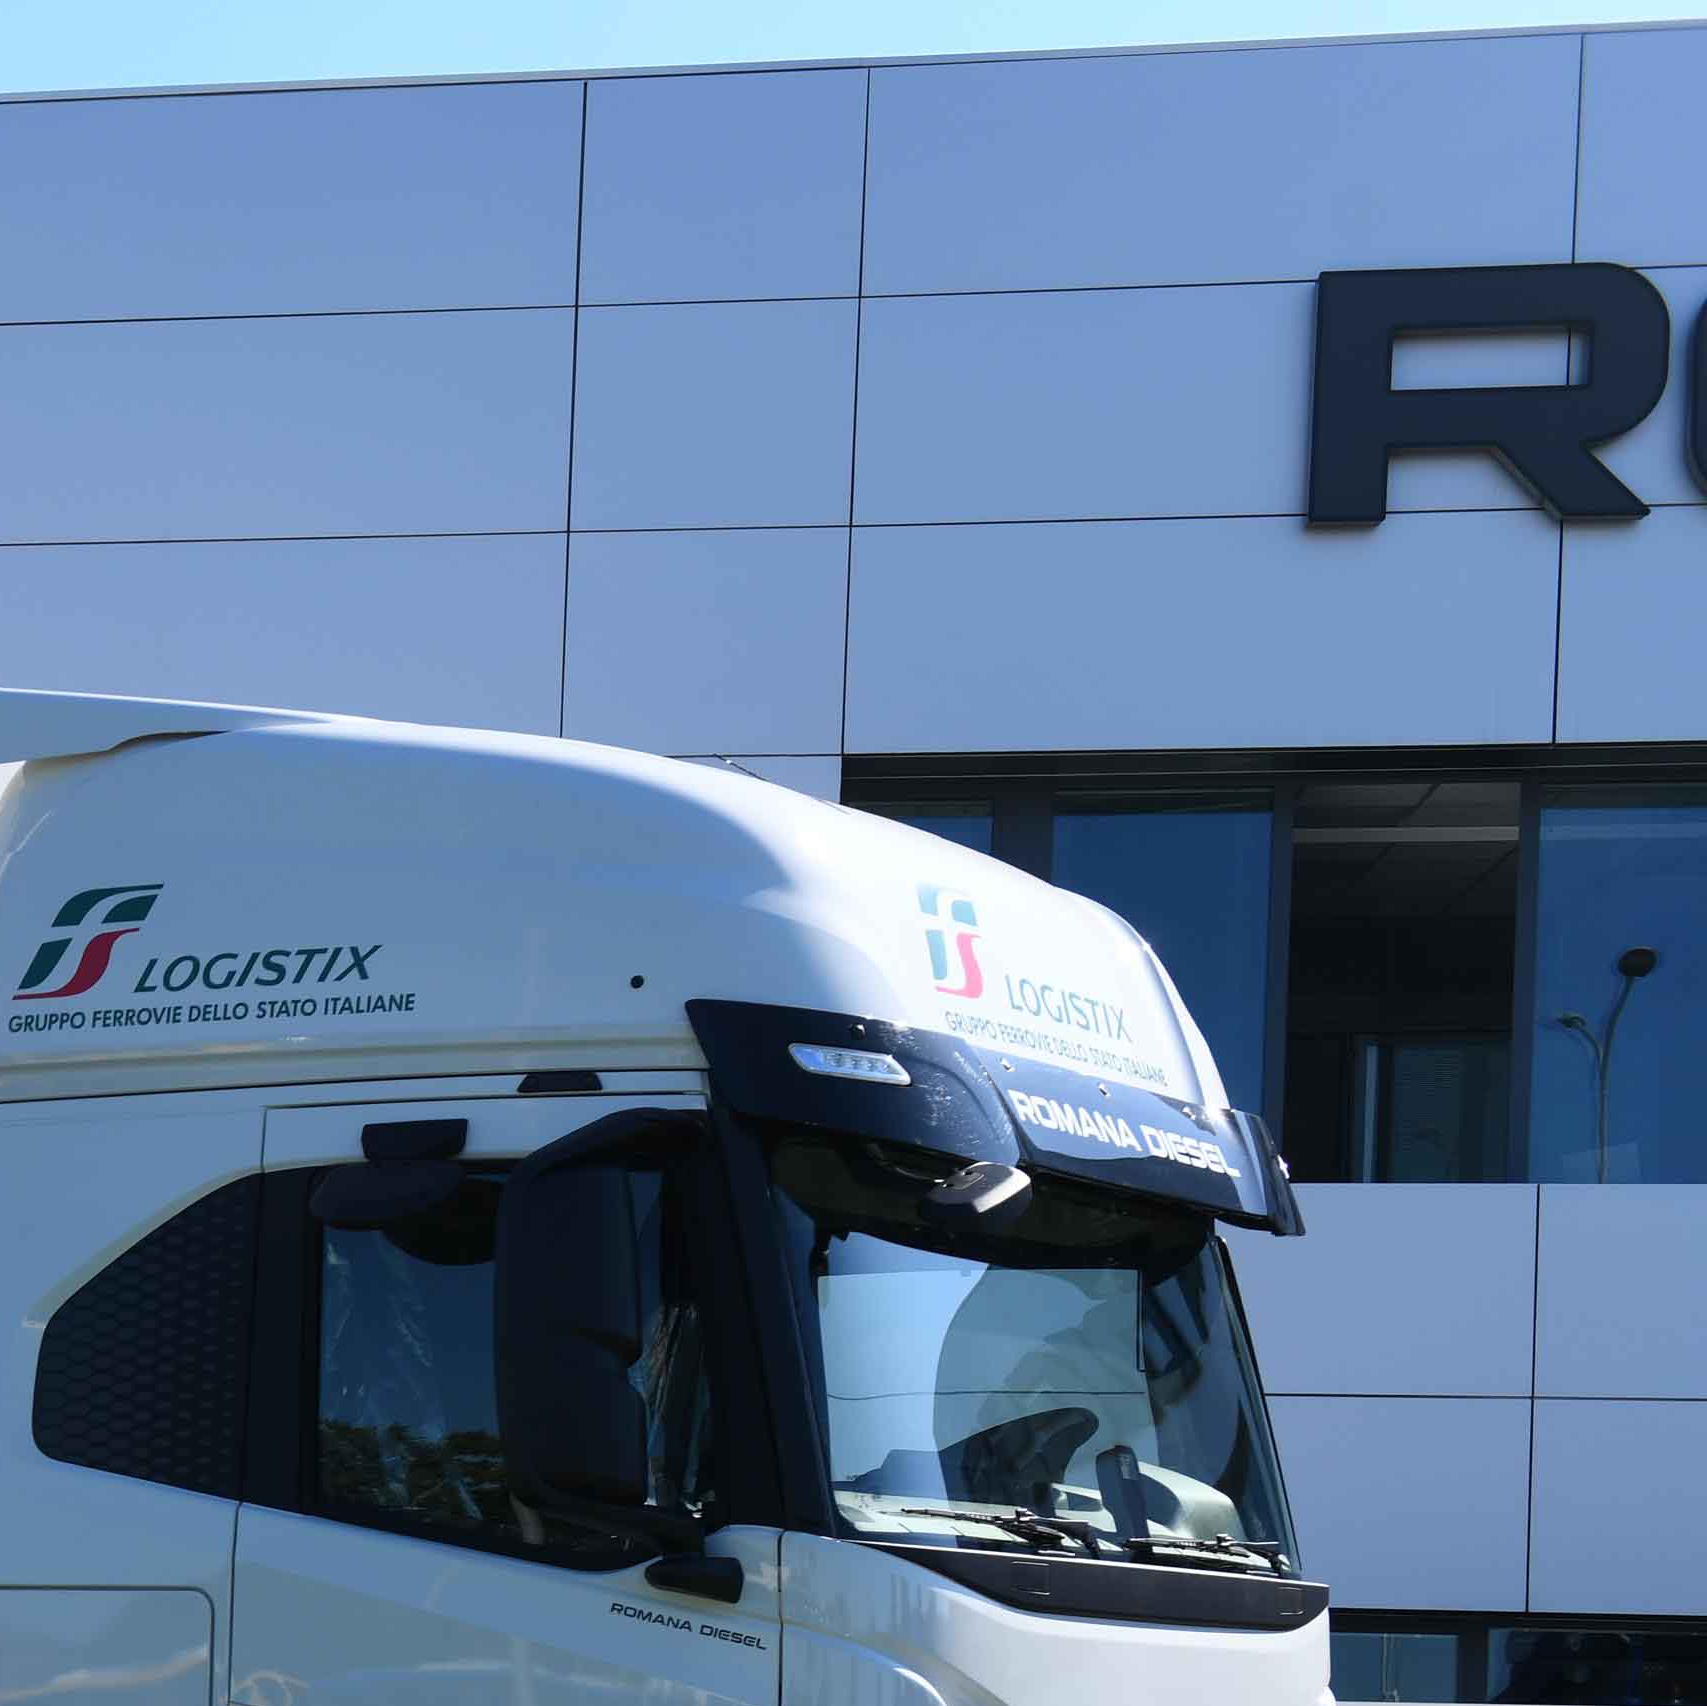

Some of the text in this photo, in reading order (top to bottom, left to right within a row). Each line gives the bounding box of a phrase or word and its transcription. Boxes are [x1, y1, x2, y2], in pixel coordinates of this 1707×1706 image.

[1307, 262, 1707, 526] R
[133, 944, 383, 993] LOGISTIX
[8, 992, 416, 1033] GRUPPO FERROVIE DELLO STATO ITALIANE
[944, 1010, 998, 1040] GRUPPO
[1004, 973, 1134, 1044] LOGISTIX
[1007, 1088, 1241, 1178] ROMANA DIESEL
[610, 1602, 768, 1650] ROMANA DIESEL
